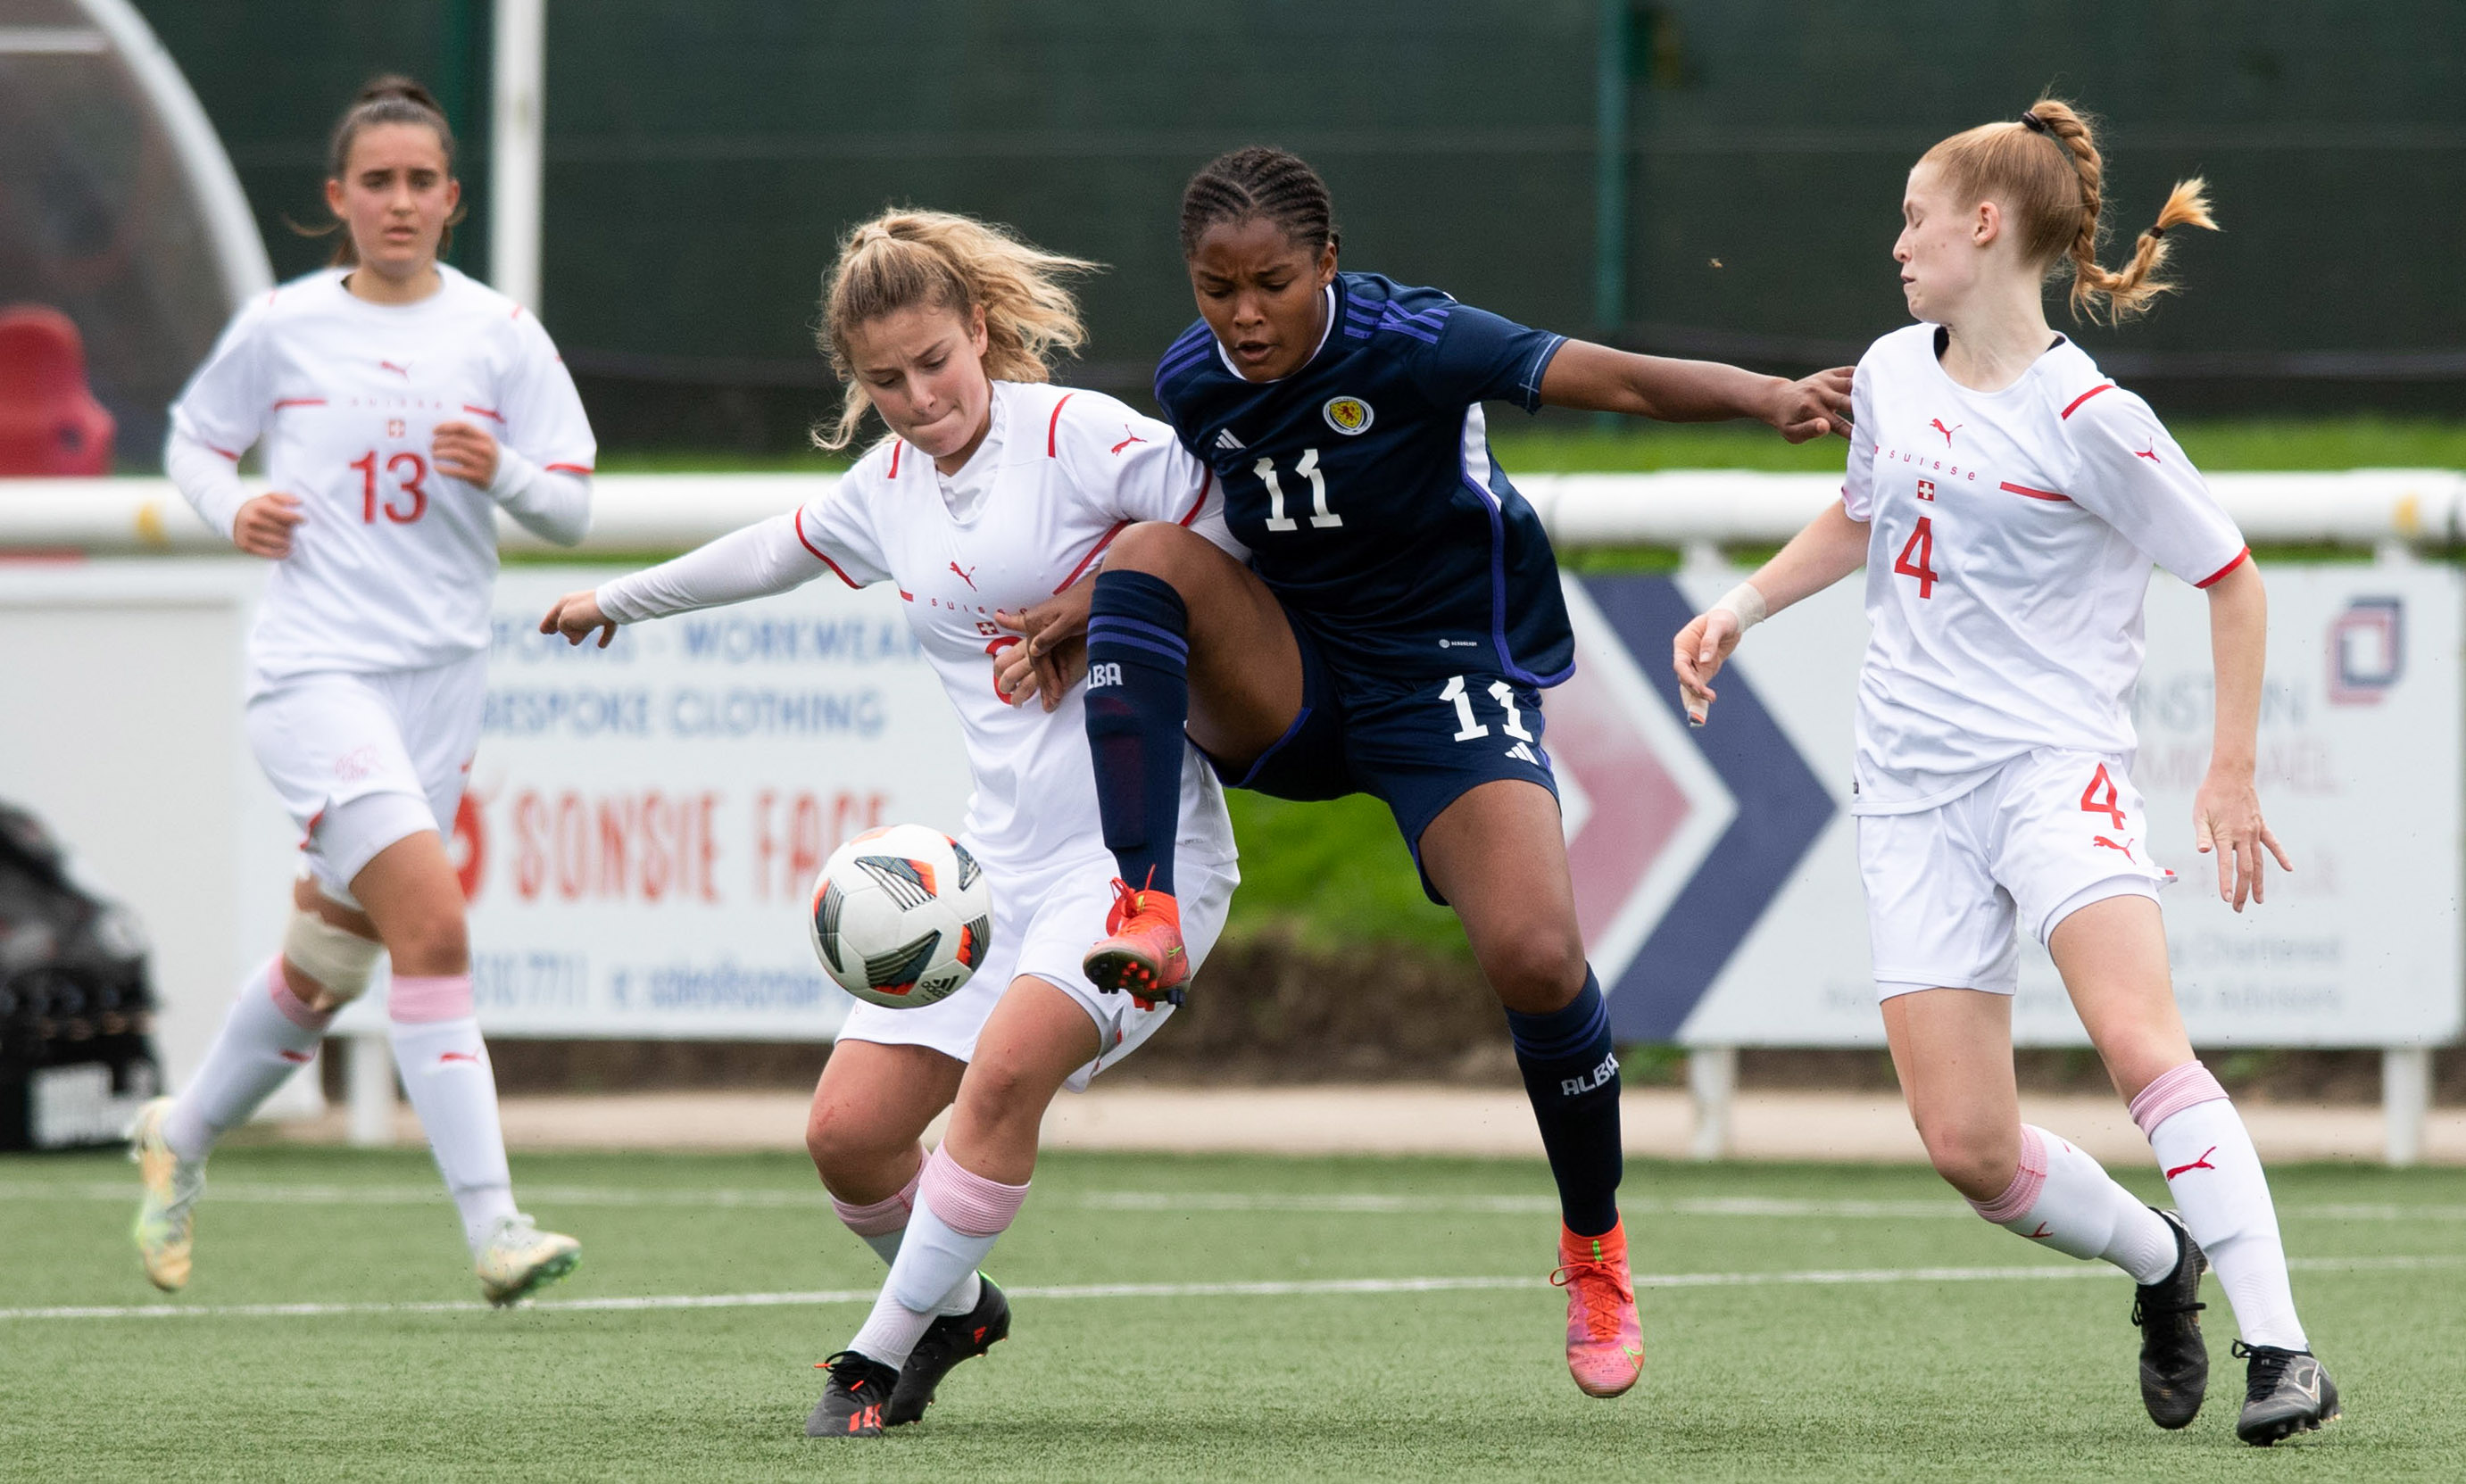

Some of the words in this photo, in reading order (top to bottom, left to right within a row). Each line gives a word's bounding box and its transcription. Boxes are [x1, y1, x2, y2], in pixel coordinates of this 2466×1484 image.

[349, 450, 428, 526] 13
[1252, 448, 1344, 532] 11
[1893, 516, 1939, 600] 4
[670, 687, 887, 737] CLOTHING
[1438, 675, 1534, 743] 11
[2080, 762, 2127, 830] 4
[511, 789, 722, 903] SONSIE
[1561, 1052, 1620, 1096] ALBA
